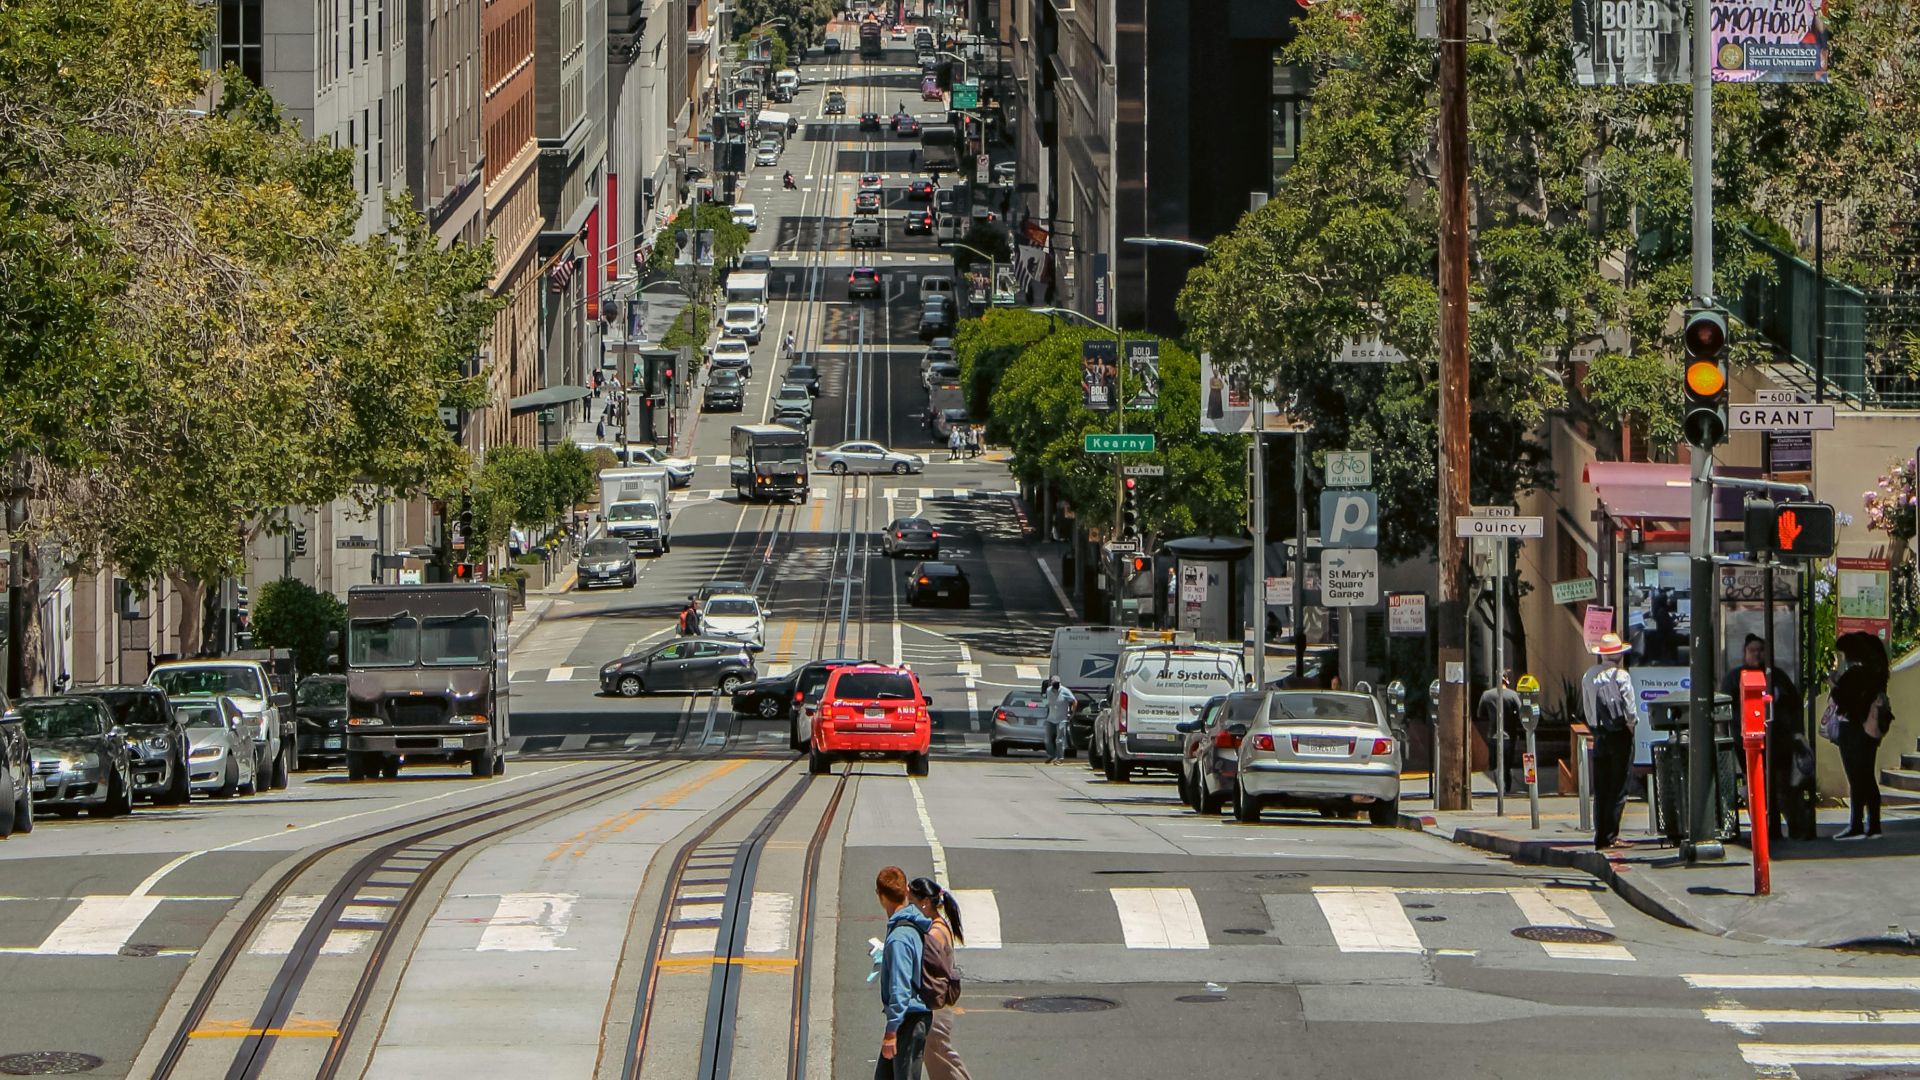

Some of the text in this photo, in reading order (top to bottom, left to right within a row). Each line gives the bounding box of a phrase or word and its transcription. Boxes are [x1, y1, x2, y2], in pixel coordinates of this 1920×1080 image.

[1602, 1, 1659, 29] BOLD
[1602, 31, 1660, 57] THEN
[1749, 46, 1817, 56] SAN FRANCISCO
[1749, 58, 1817, 67] STATE UNIVERSITY
[1132, 347, 1151, 356] BOLD
[1091, 386, 1109, 395] BOLD
[1770, 393, 1792, 402] 600
[1740, 410, 1814, 425] GRANT
[1093, 438, 1146, 450] Kearny
[1488, 509, 1511, 517] END
[1474, 521, 1527, 534] Quincy
[1329, 569, 1375, 581] St Mary's
[1329, 580, 1363, 589] Square
[1555, 580, 1593, 591] PEDESTRIAN
[1329, 589, 1365, 600] Garage
[1556, 587, 1593, 598] ENTRANCE
[1389, 596, 1424, 607] NO PARKING
[1156, 669, 1229, 681] Air Systems
